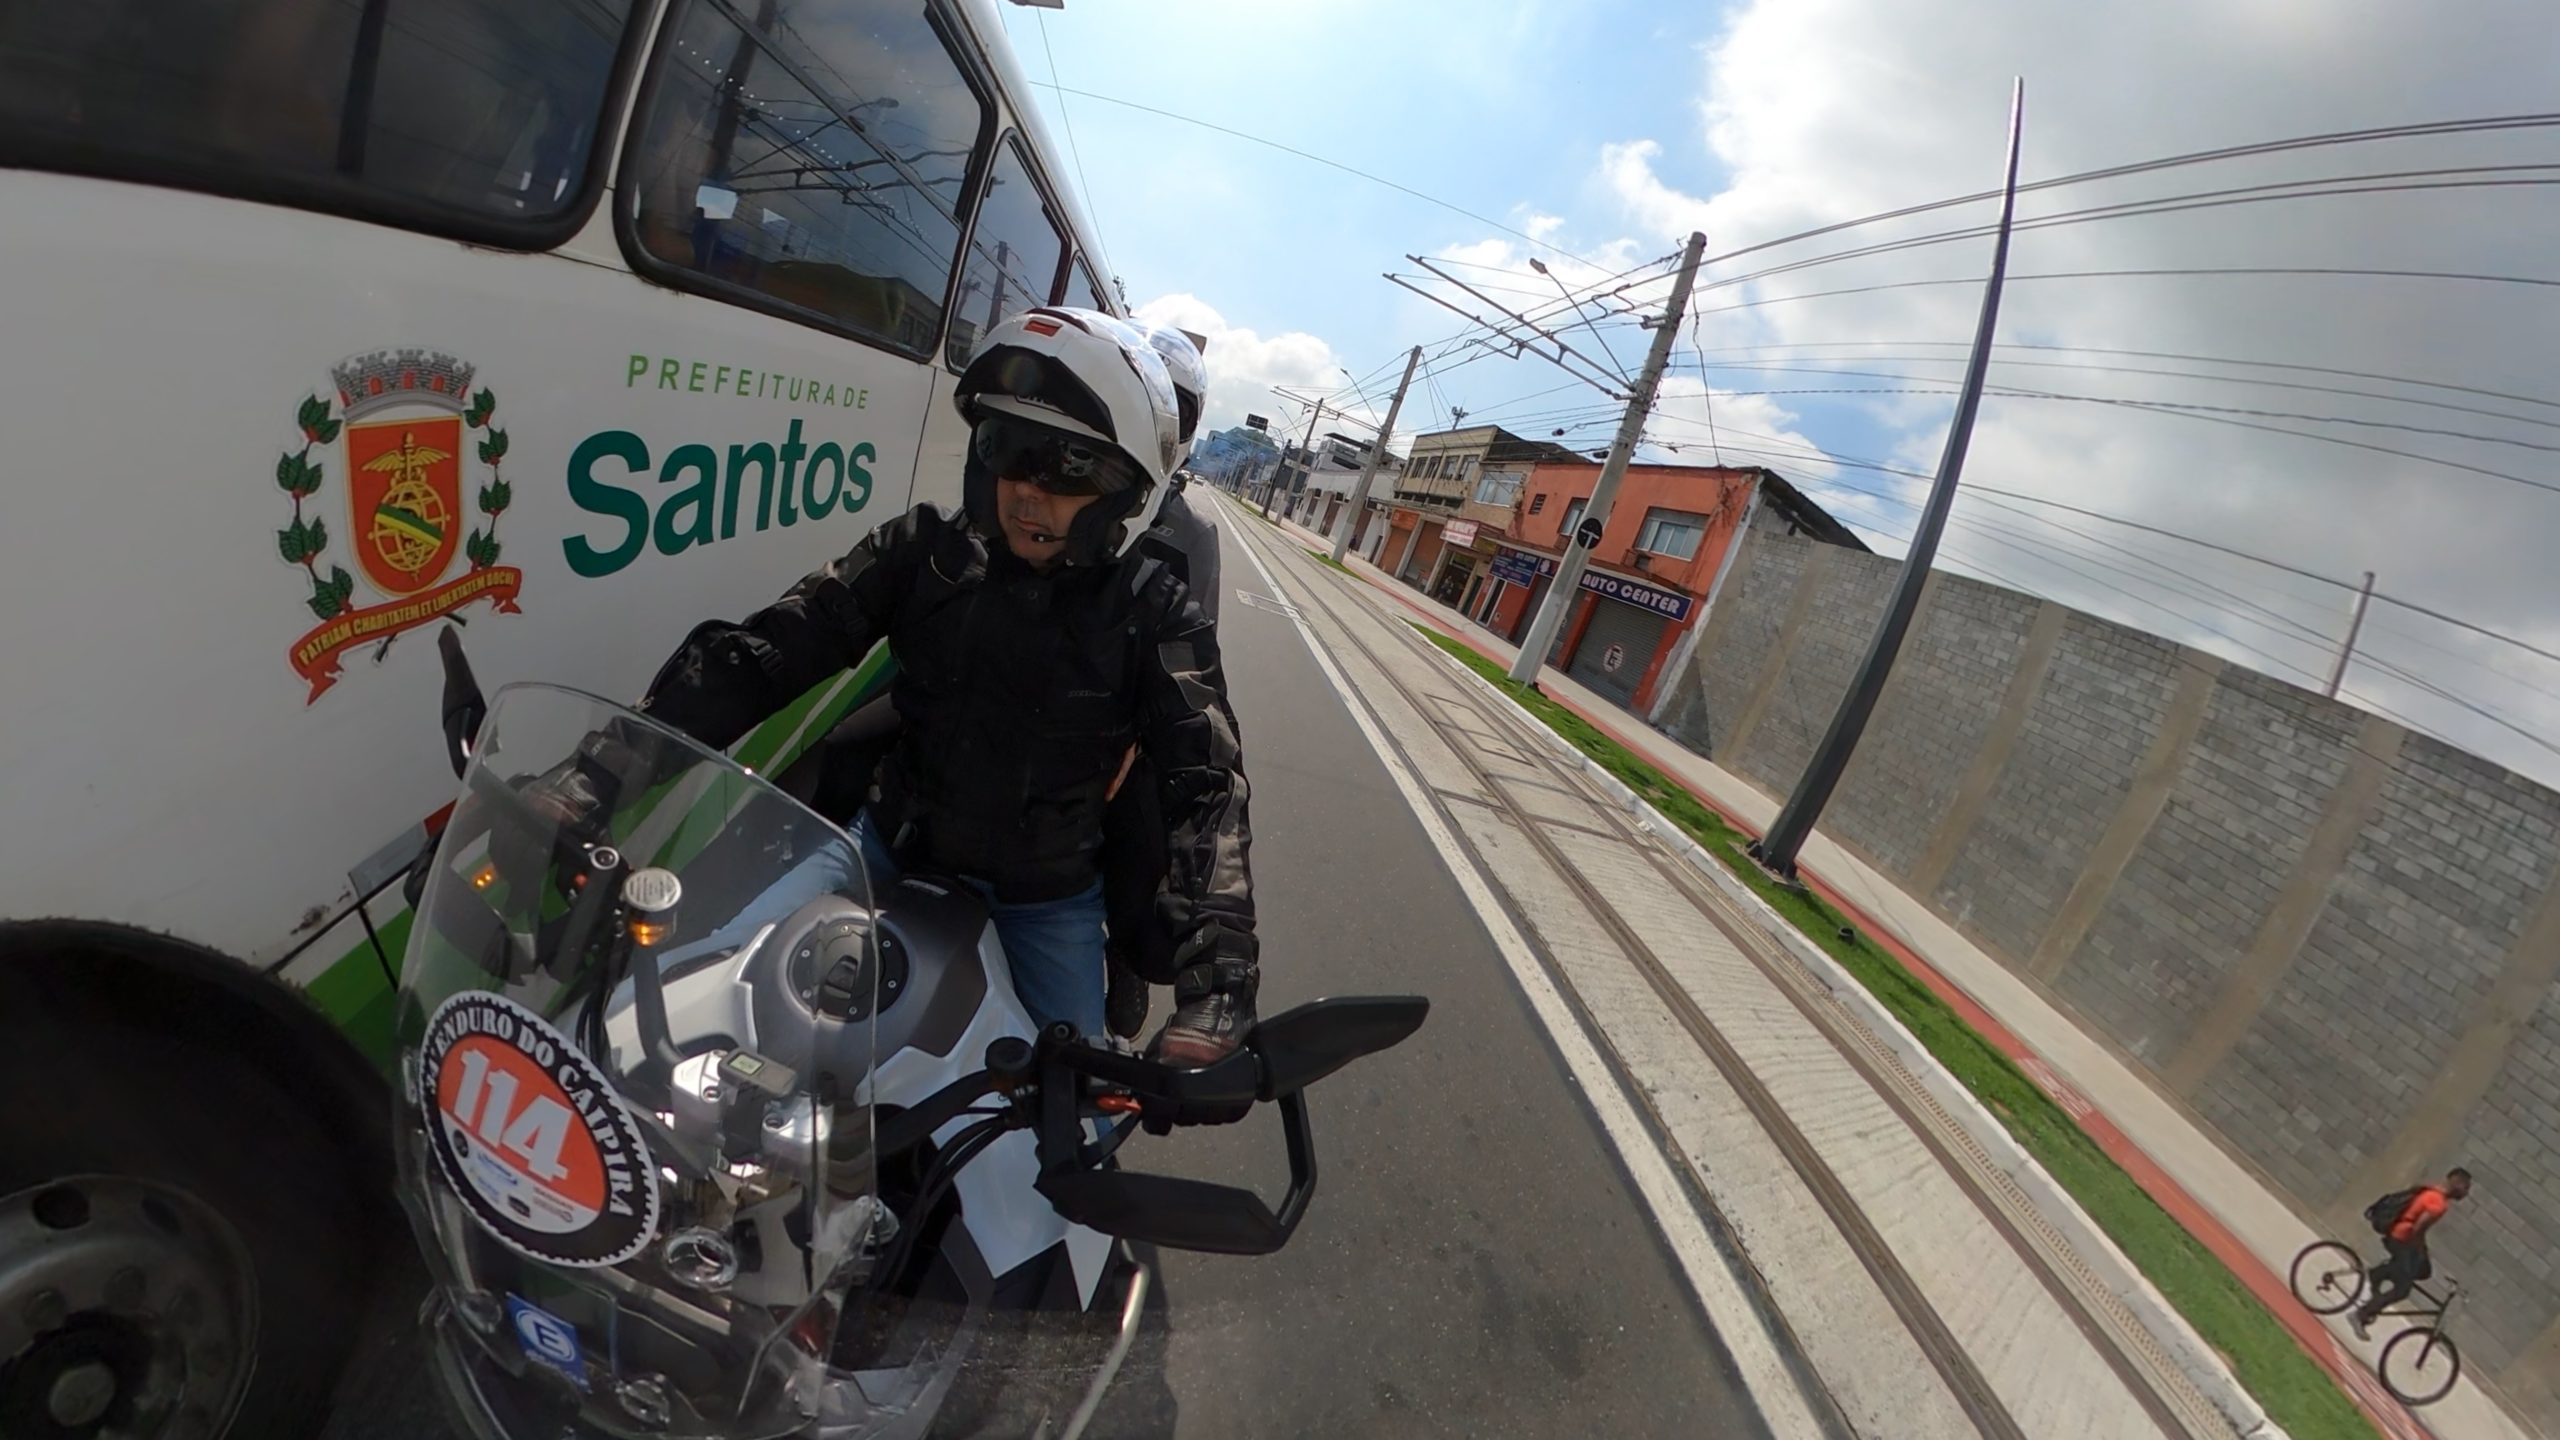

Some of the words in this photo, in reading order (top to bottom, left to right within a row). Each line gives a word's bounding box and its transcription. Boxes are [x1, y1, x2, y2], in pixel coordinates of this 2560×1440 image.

[626, 354, 835, 406] PREFEITURA
[843, 386, 869, 410] DE
[561, 418, 877, 578] Santos
[298, 621, 352, 666] PATRIAM
[420, 600, 432, 617] ET
[1582, 573, 1618, 593] AUTO
[1620, 584, 1681, 615] CENTER
[434, 1007, 514, 1059] ENDURO
[516, 1023, 555, 1067] DO
[558, 1064, 634, 1216] CAIPIRA
[453, 1048, 574, 1182] 114
